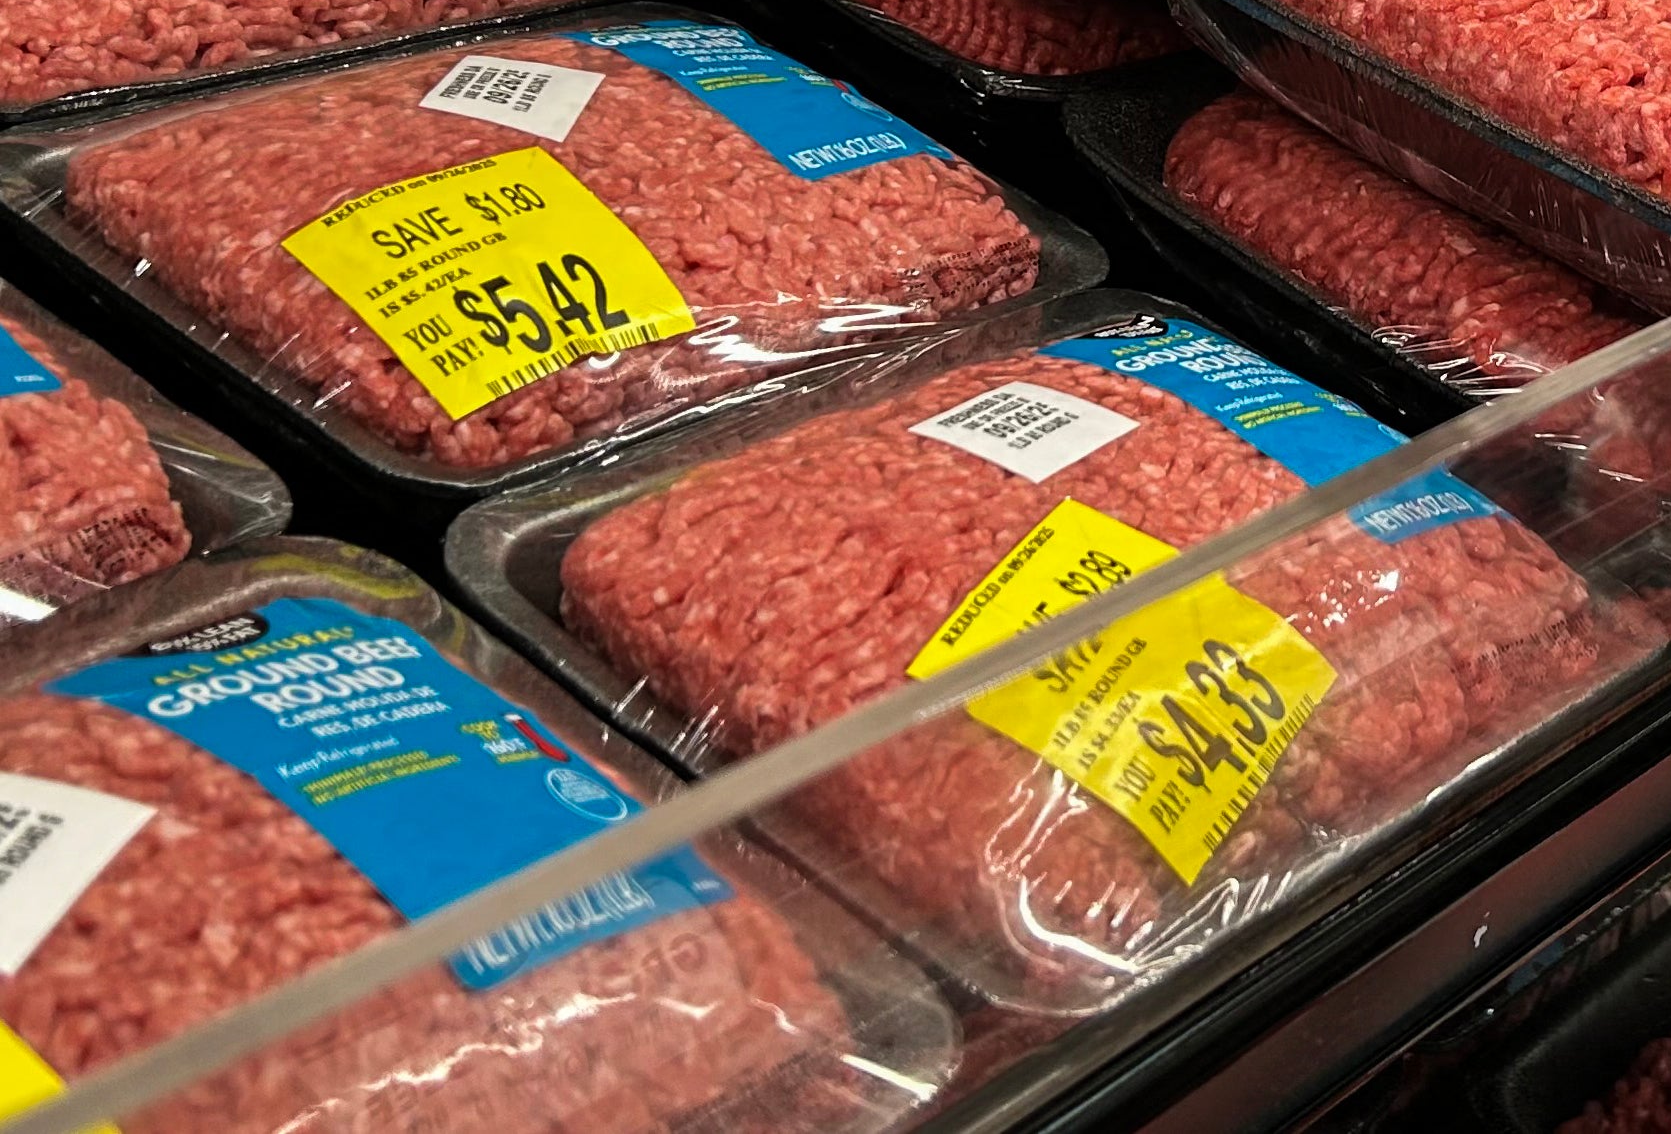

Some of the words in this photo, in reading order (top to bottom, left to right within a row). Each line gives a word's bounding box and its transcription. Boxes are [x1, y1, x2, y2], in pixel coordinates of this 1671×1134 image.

[322, 185, 406, 227] REDUCED
[407, 179, 428, 189] on
[371, 206, 464, 259] SAVE
[464, 182, 547, 226] $1.80
[364, 278, 399, 301] 1LB
[397, 267, 418, 283] 85
[418, 240, 482, 272] ROUND
[379, 301, 402, 318] IS
[400, 267, 473, 306] $5.42/EA
[402, 312, 454, 353] YOU
[452, 253, 630, 355] $5.42
[430, 336, 485, 378] PAY!
[1054, 550, 1132, 596] $289
[940, 581, 1002, 647] REDUCED
[147, 651, 340, 718] GROUND
[331, 635, 422, 665] BEEF
[154, 664, 214, 686] ALL
[249, 665, 406, 714] ROUND
[1088, 652, 1132, 705] ROUND
[278, 703, 345, 729] CARNE
[412, 684, 440, 700] DE
[1133, 637, 1287, 794] $4.33
[1078, 748, 1098, 770] IS
[1113, 754, 1157, 802] YOU
[1149, 778, 1192, 835] PAY!
